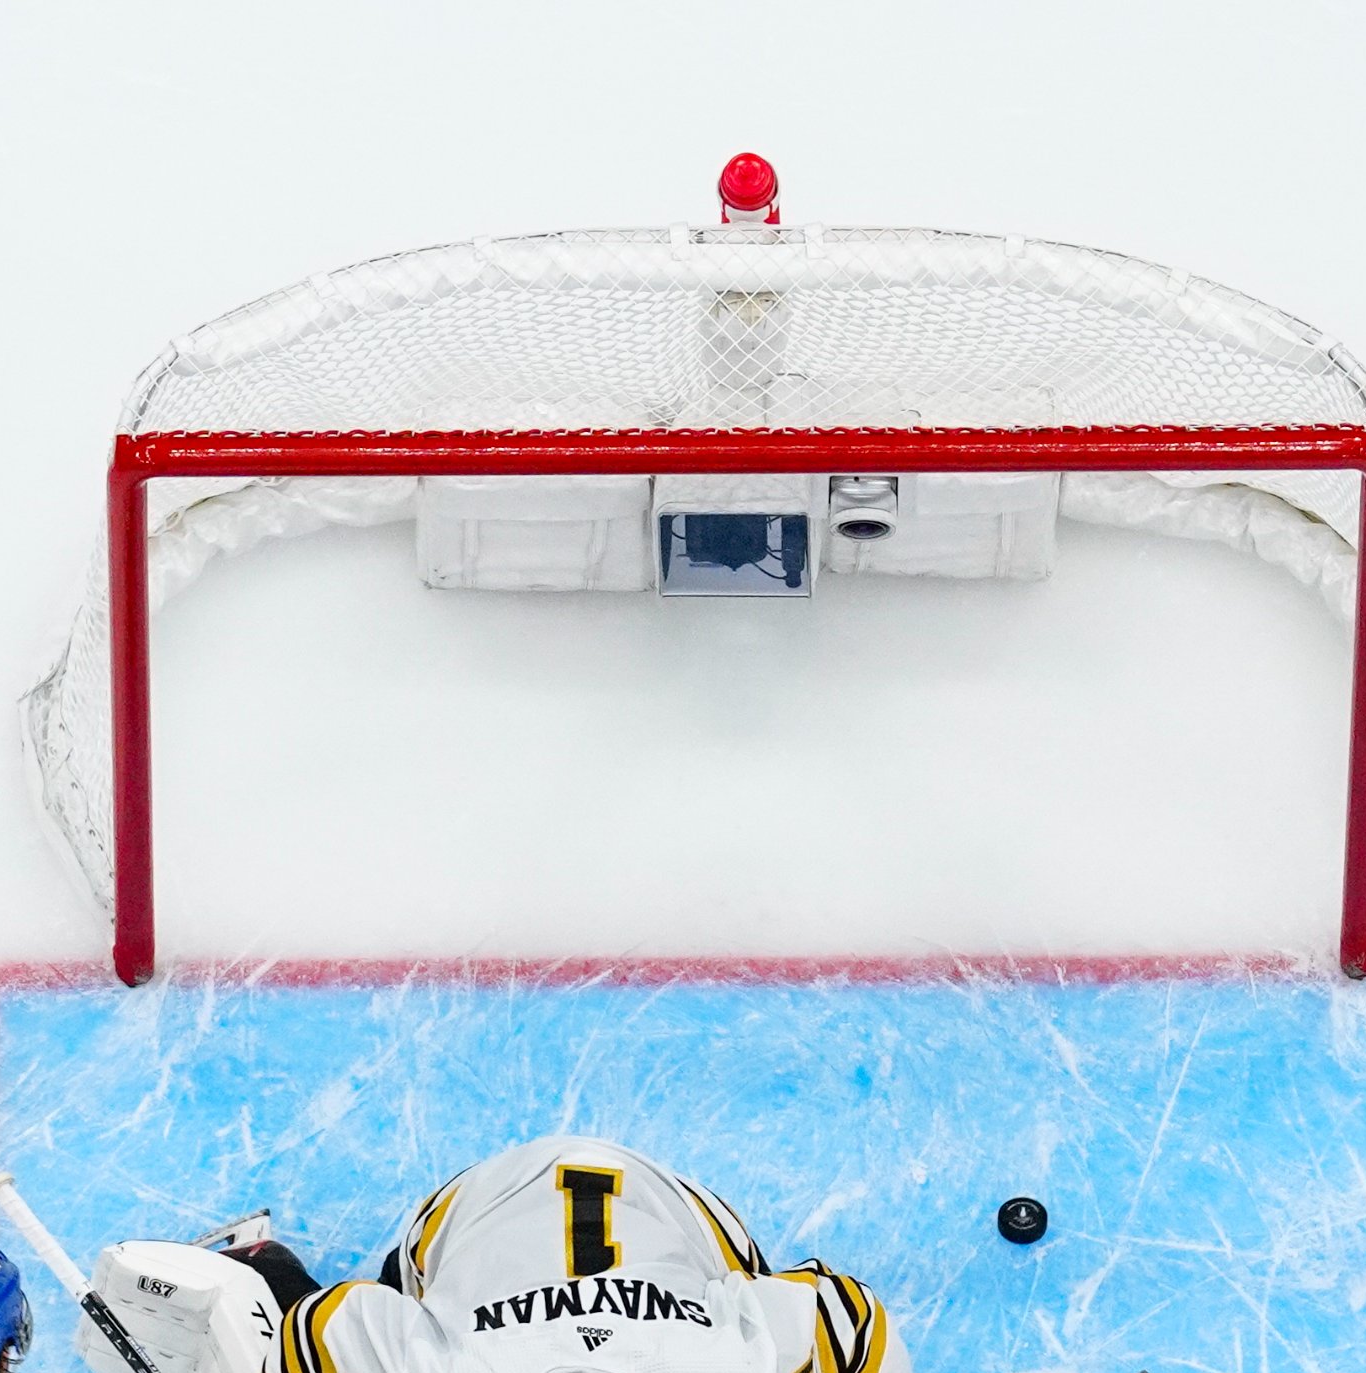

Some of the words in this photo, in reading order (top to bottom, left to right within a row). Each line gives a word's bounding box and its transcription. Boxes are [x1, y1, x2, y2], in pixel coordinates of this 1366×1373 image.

[556, 1165, 624, 1280] 1
[473, 1277, 713, 1332] SWAYMAN
[576, 1325, 614, 1338] adidas
